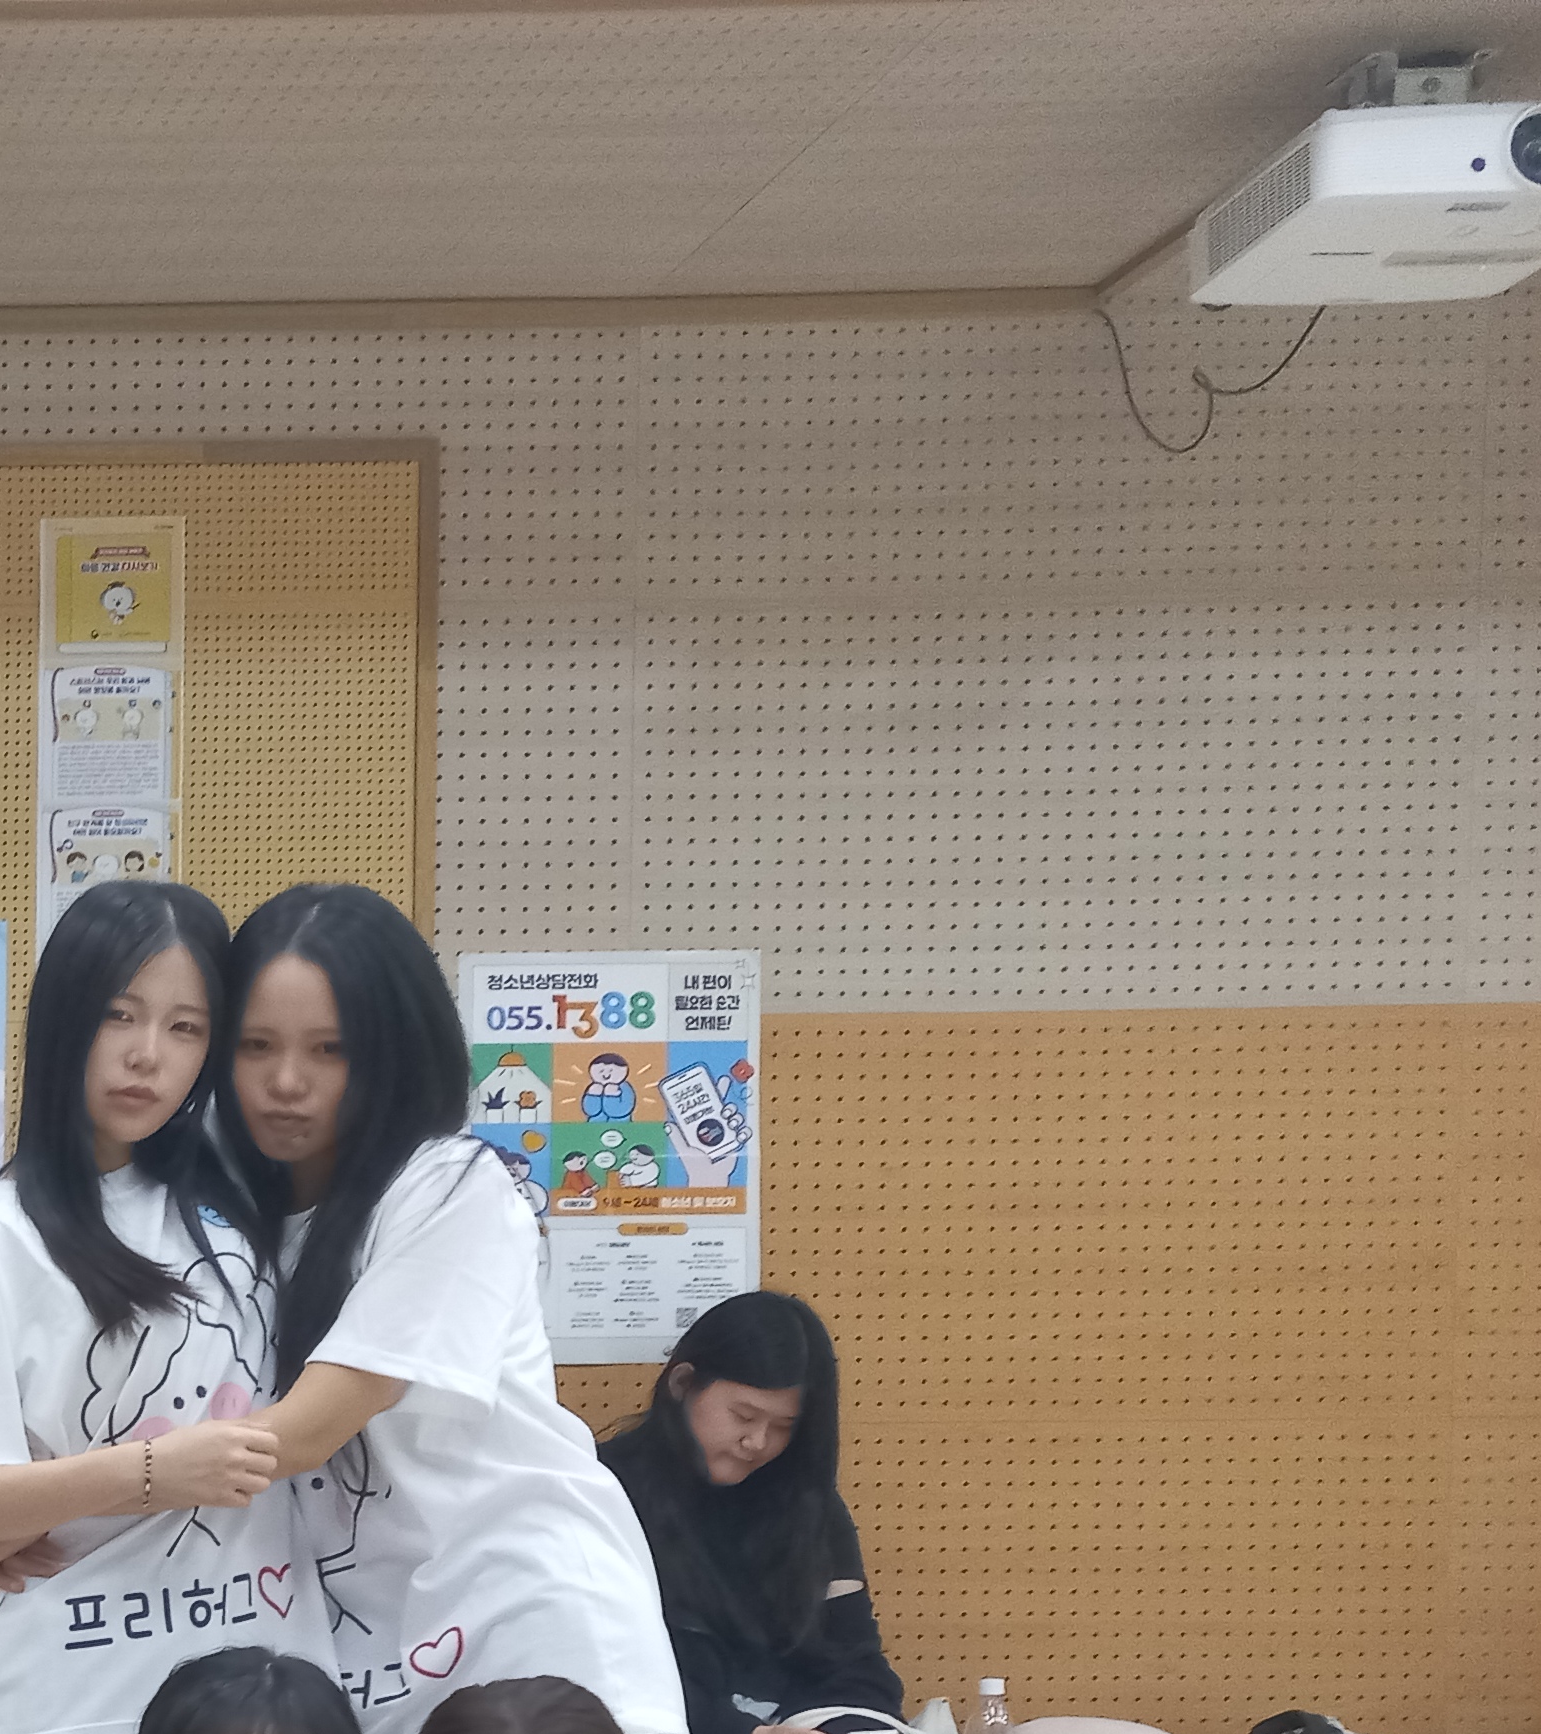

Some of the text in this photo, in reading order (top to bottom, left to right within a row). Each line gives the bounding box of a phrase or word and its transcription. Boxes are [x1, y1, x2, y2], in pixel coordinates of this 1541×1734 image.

[487, 973, 599, 991] 청소년상담전화
[684, 974, 732, 991] 내 편이
[675, 994, 741, 1012] 필요한 순간
[685, 1014, 733, 1031] 언제든!
[64, 1572, 258, 1651] 프리허그
